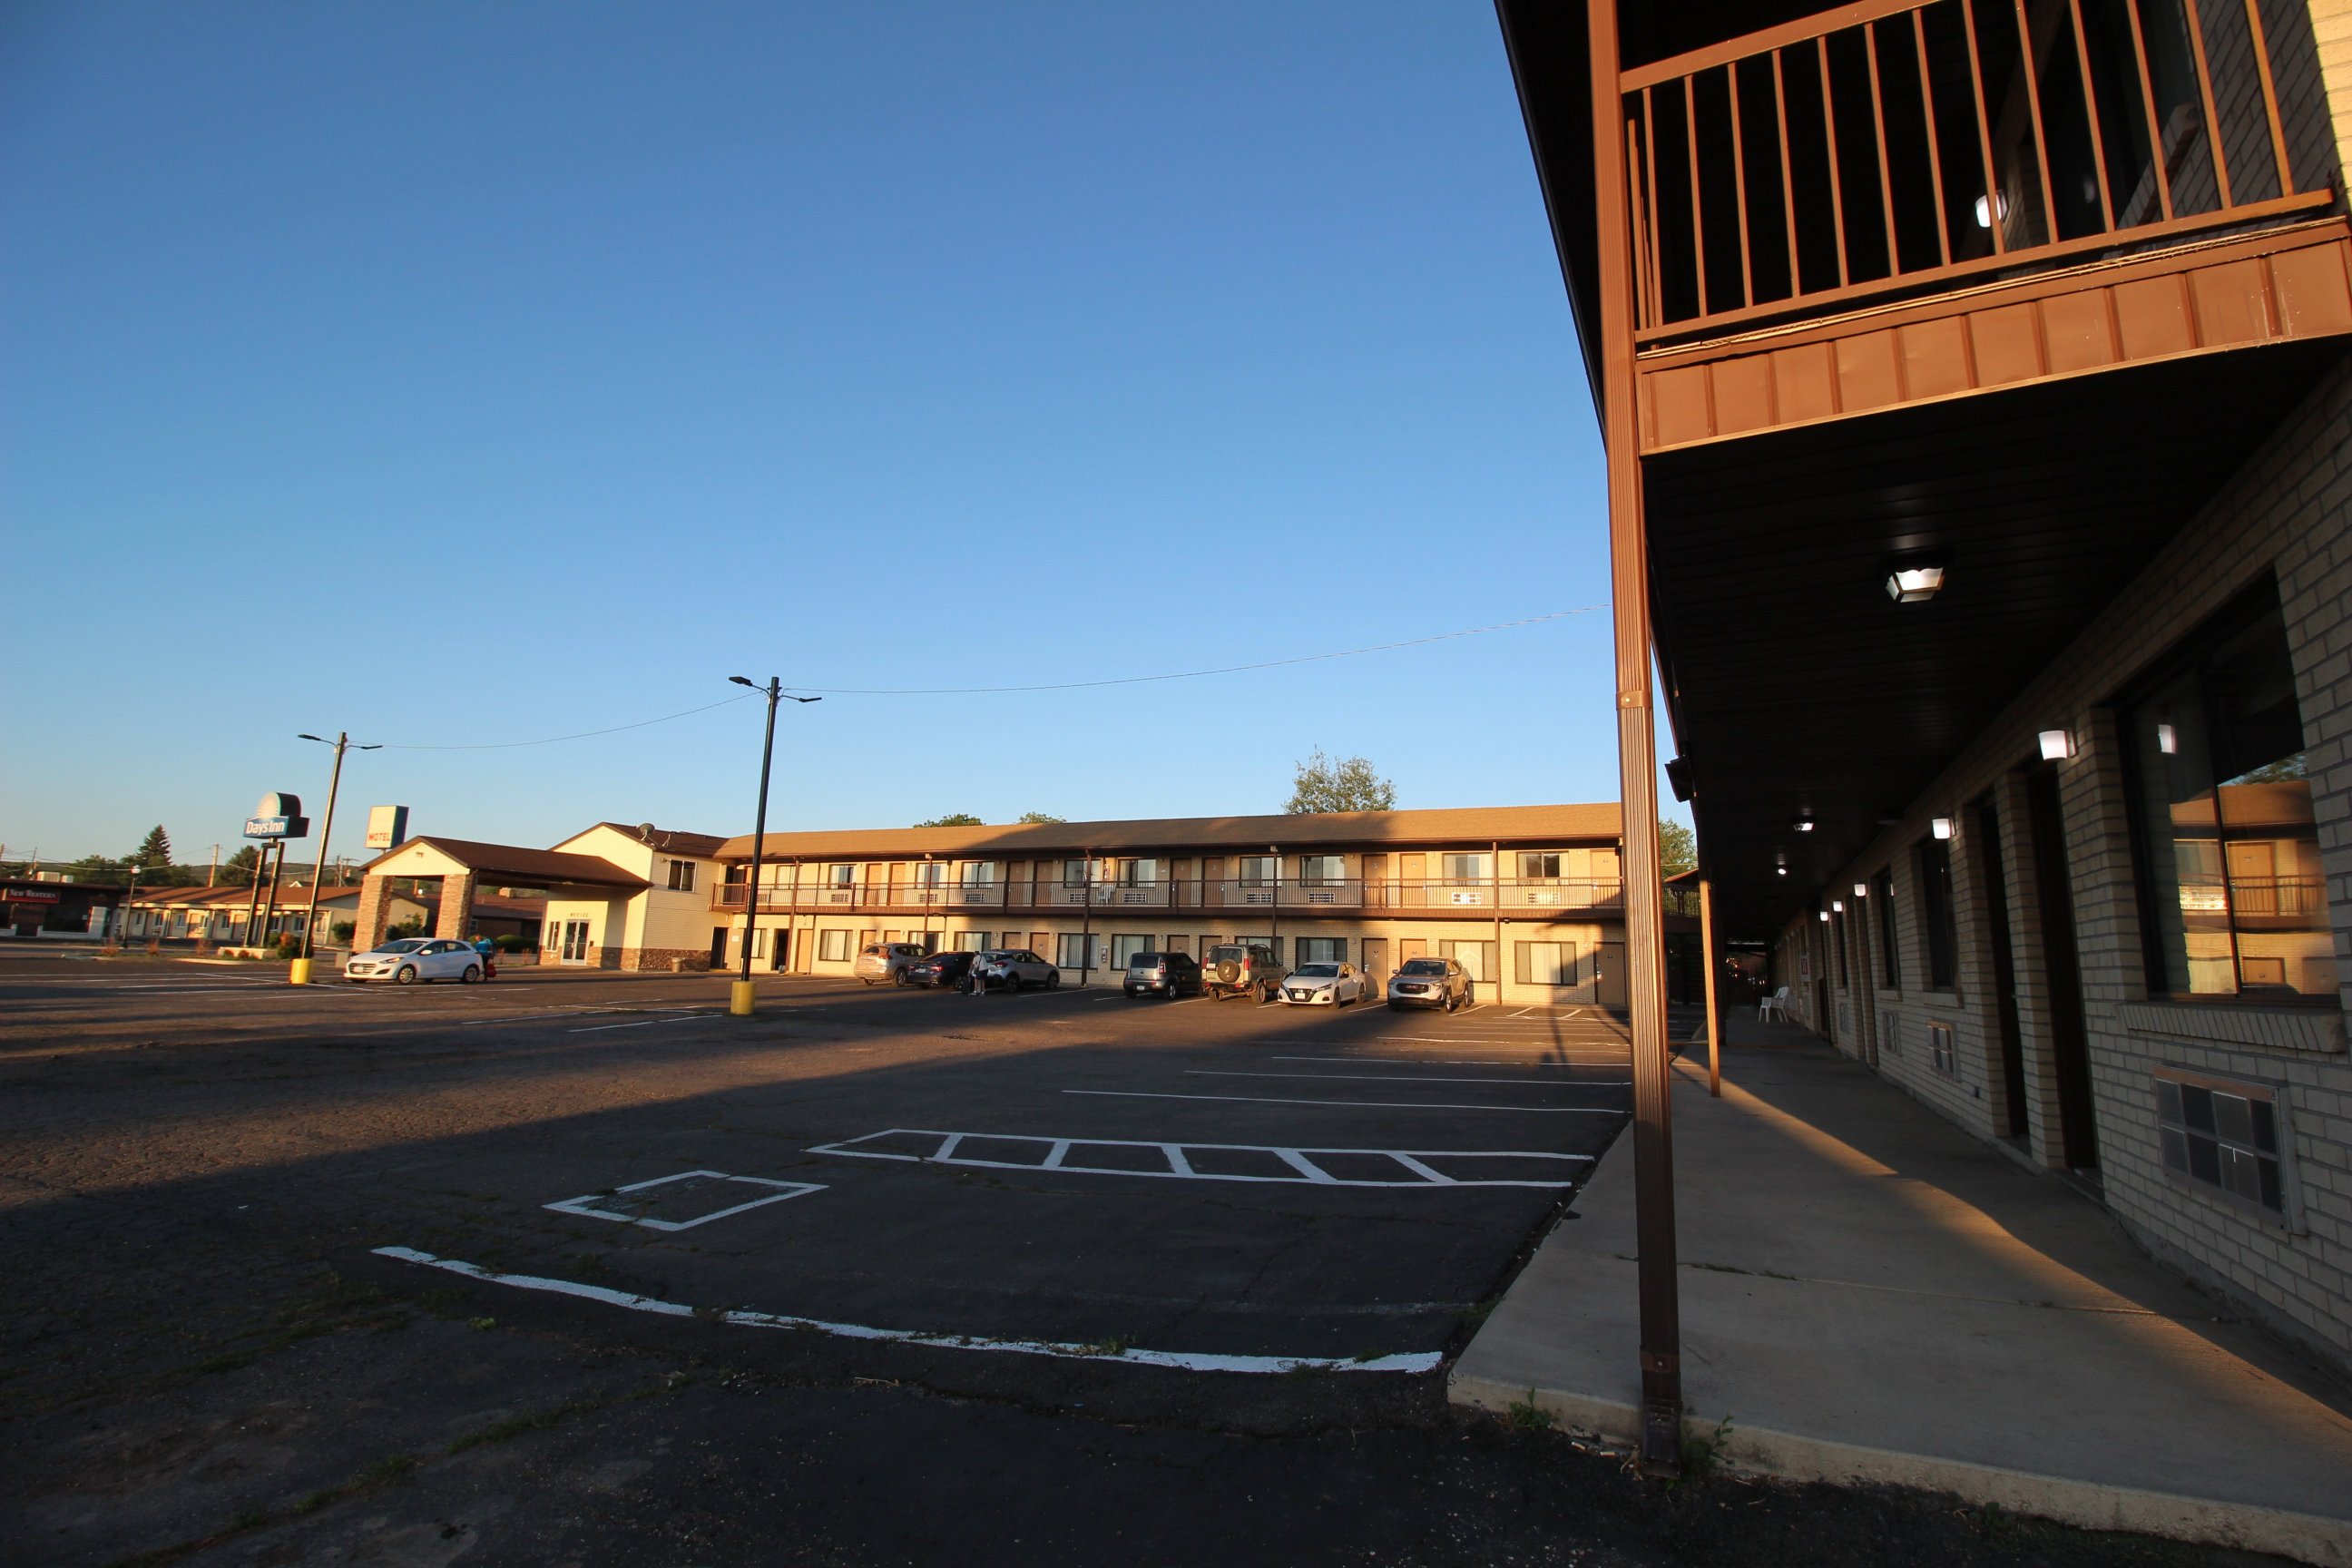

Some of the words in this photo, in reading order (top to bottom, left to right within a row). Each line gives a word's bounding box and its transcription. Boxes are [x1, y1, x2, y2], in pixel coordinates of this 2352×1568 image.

[246, 821, 269, 836] Days
[269, 820, 285, 833] Inn
[368, 832, 390, 841] MOTEL
